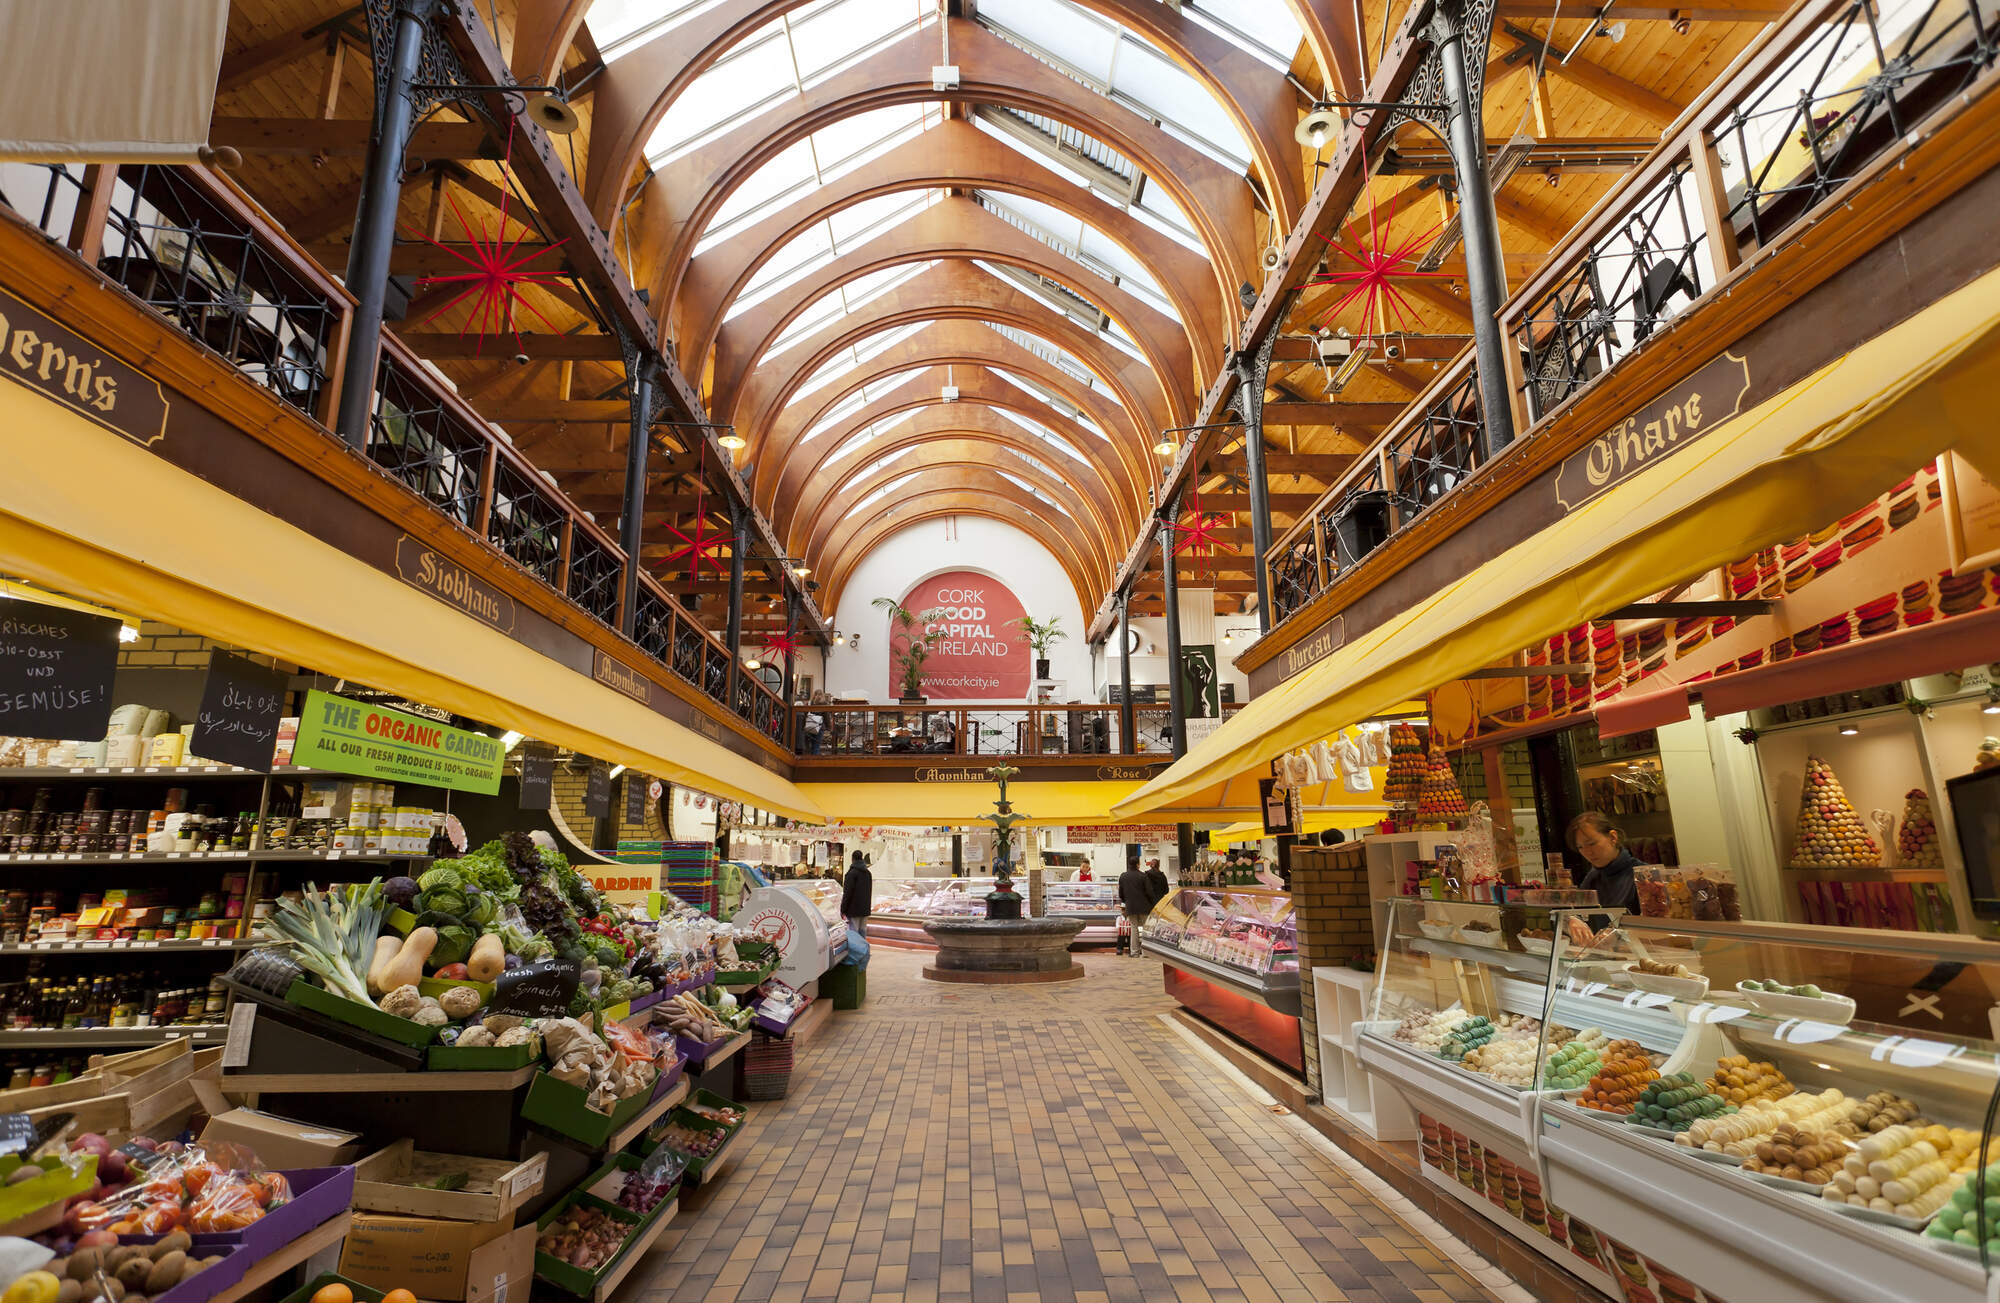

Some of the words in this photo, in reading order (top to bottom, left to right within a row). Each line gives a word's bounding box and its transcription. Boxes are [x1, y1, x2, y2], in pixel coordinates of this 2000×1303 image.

[937, 589, 985, 604] CORK
[935, 607, 986, 621] FOOD
[925, 624, 995, 638] CAPITAL
[911, 640, 936, 655] OF
[938, 641, 1008, 656] IRELAND
[1287, 632, 1332, 673] Durcan
[26, 665, 55, 677] UND
[920, 675, 1000, 690] www.corkcity.ie
[323, 701, 361, 731] THE
[365, 713, 443, 749] ORGANIC
[445, 732, 498, 762] GARDEN
[317, 738, 337, 752] ALL
[341, 742, 362, 757] OUR
[365, 747, 394, 763] FRESH
[395, 753, 434, 770] PRODUCE
[434, 760, 443, 771] IS
[444, 762, 464, 775] 100%
[465, 766, 494, 780] ORGANIC
[926, 767, 985, 782] Moynihan
[1106, 766, 1140, 778] Rose
[880, 828, 912, 837] OULTRY
